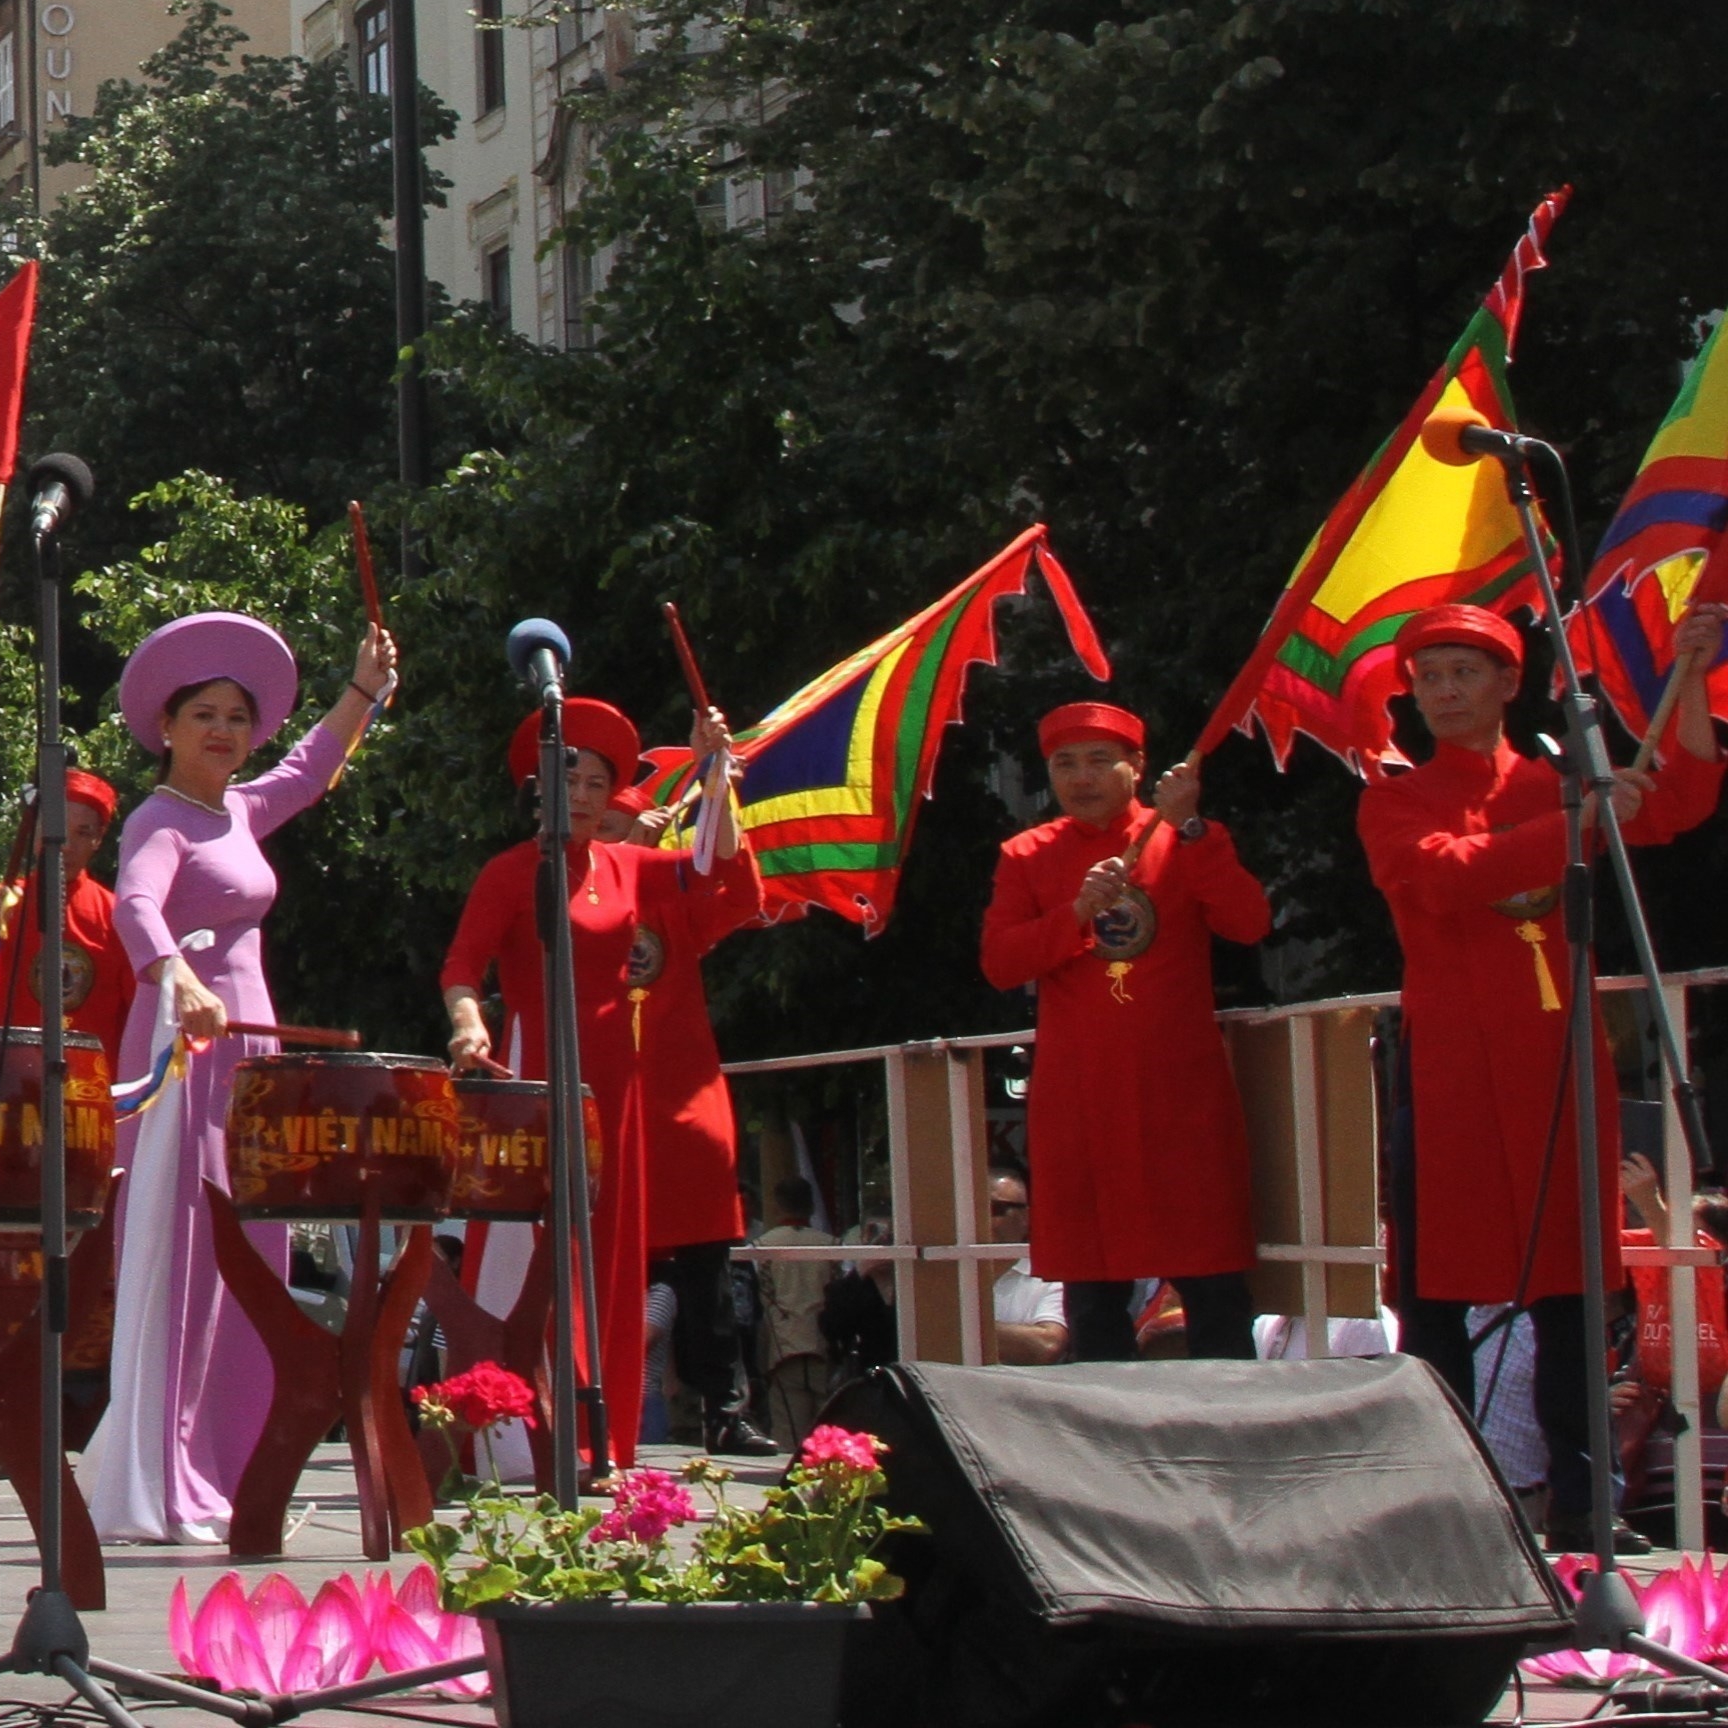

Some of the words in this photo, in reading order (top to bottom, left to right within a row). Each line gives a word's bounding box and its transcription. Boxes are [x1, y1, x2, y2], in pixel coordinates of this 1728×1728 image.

[282, 1106, 360, 1162] VIỆT
[371, 1117, 444, 1157] NAM
[480, 1127, 546, 1173] VIỆT
